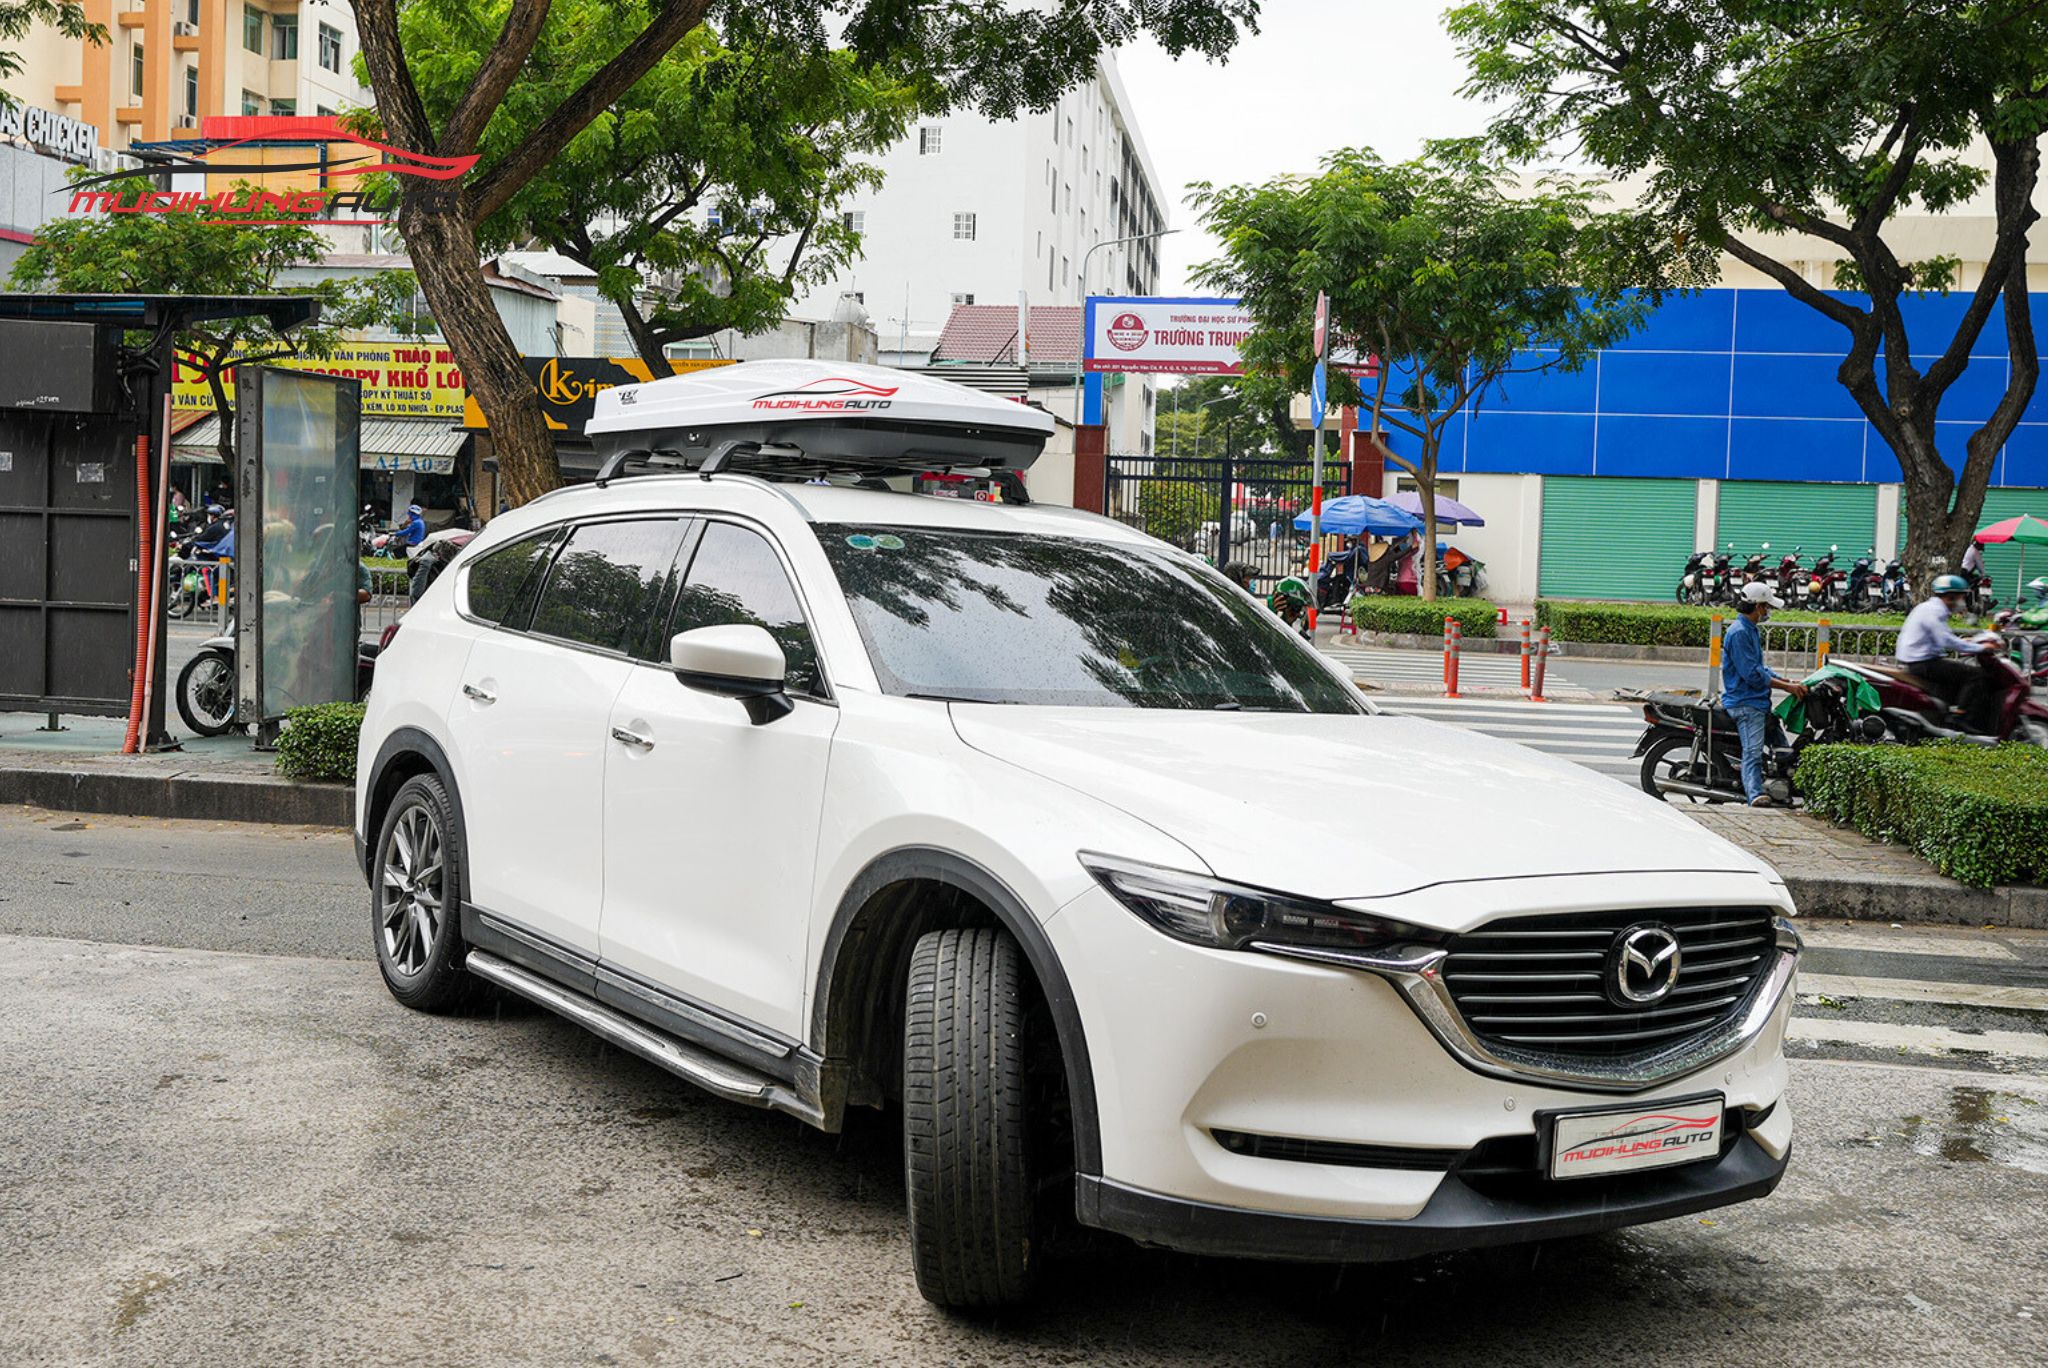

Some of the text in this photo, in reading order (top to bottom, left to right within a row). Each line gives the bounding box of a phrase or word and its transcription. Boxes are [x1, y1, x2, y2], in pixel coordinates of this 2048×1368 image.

[25, 106, 99, 159] CHICKEN
[1154, 327, 1204, 346] TRƯỜNG
[357, 349, 390, 362] PHÒNG
[393, 347, 431, 364] THẢO
[387, 365, 429, 388] KHỔ
